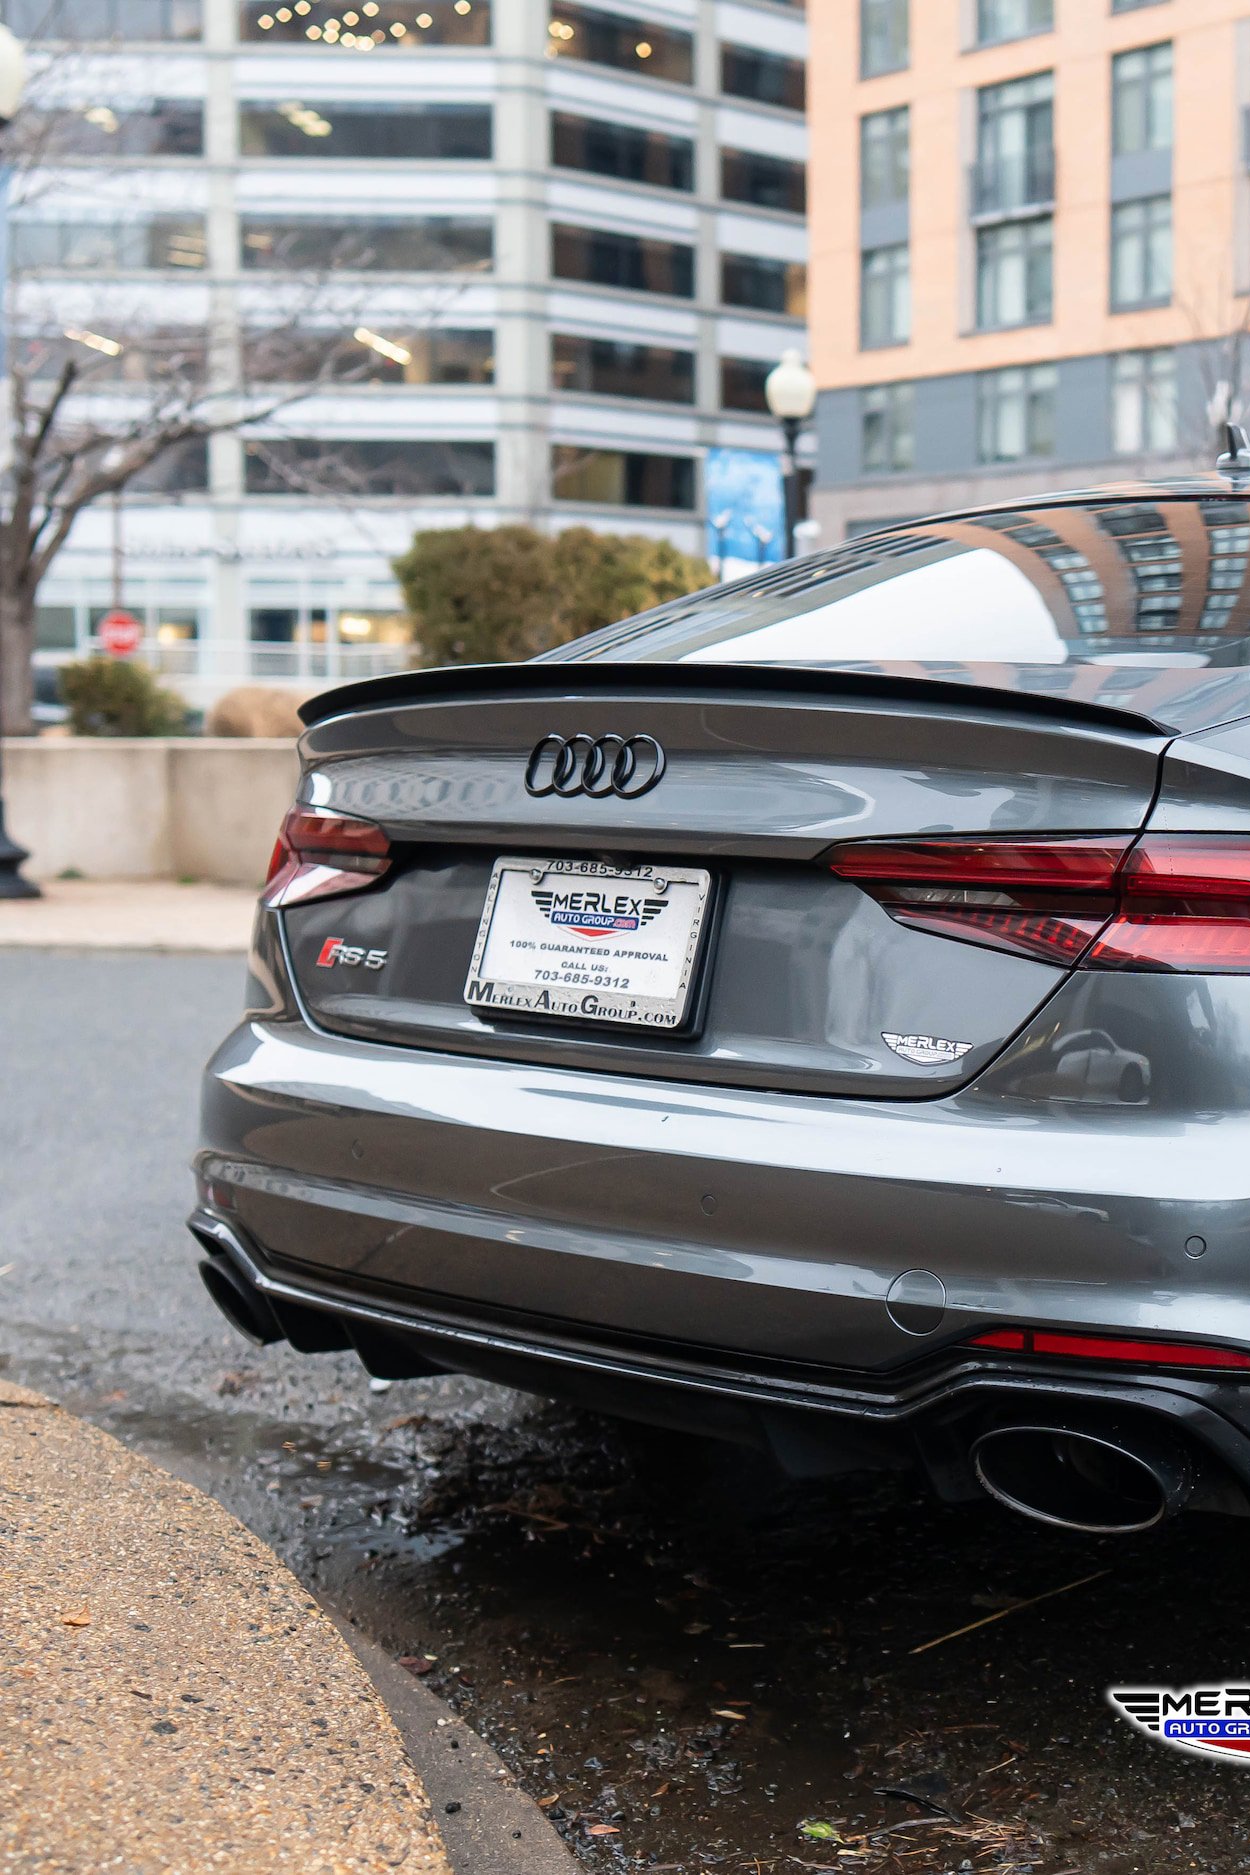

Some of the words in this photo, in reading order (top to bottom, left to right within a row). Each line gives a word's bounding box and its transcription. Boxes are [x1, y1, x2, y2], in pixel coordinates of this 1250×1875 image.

[553, 892, 642, 916] MERLEX
[471, 872, 499, 973] ARLINGTON
[553, 912, 580, 924] AUTO
[510, 940, 536, 950] 100%
[540, 943, 610, 956] GUARANTEED
[613, 950, 669, 962] APPROVAL
[678, 893, 706, 990] VIRGINIA
[561, 961, 587, 971] CALL
[590, 964, 609, 972] US:
[534, 969, 630, 989] 703-685-9312
[897, 1035, 955, 1053] MERLEX
